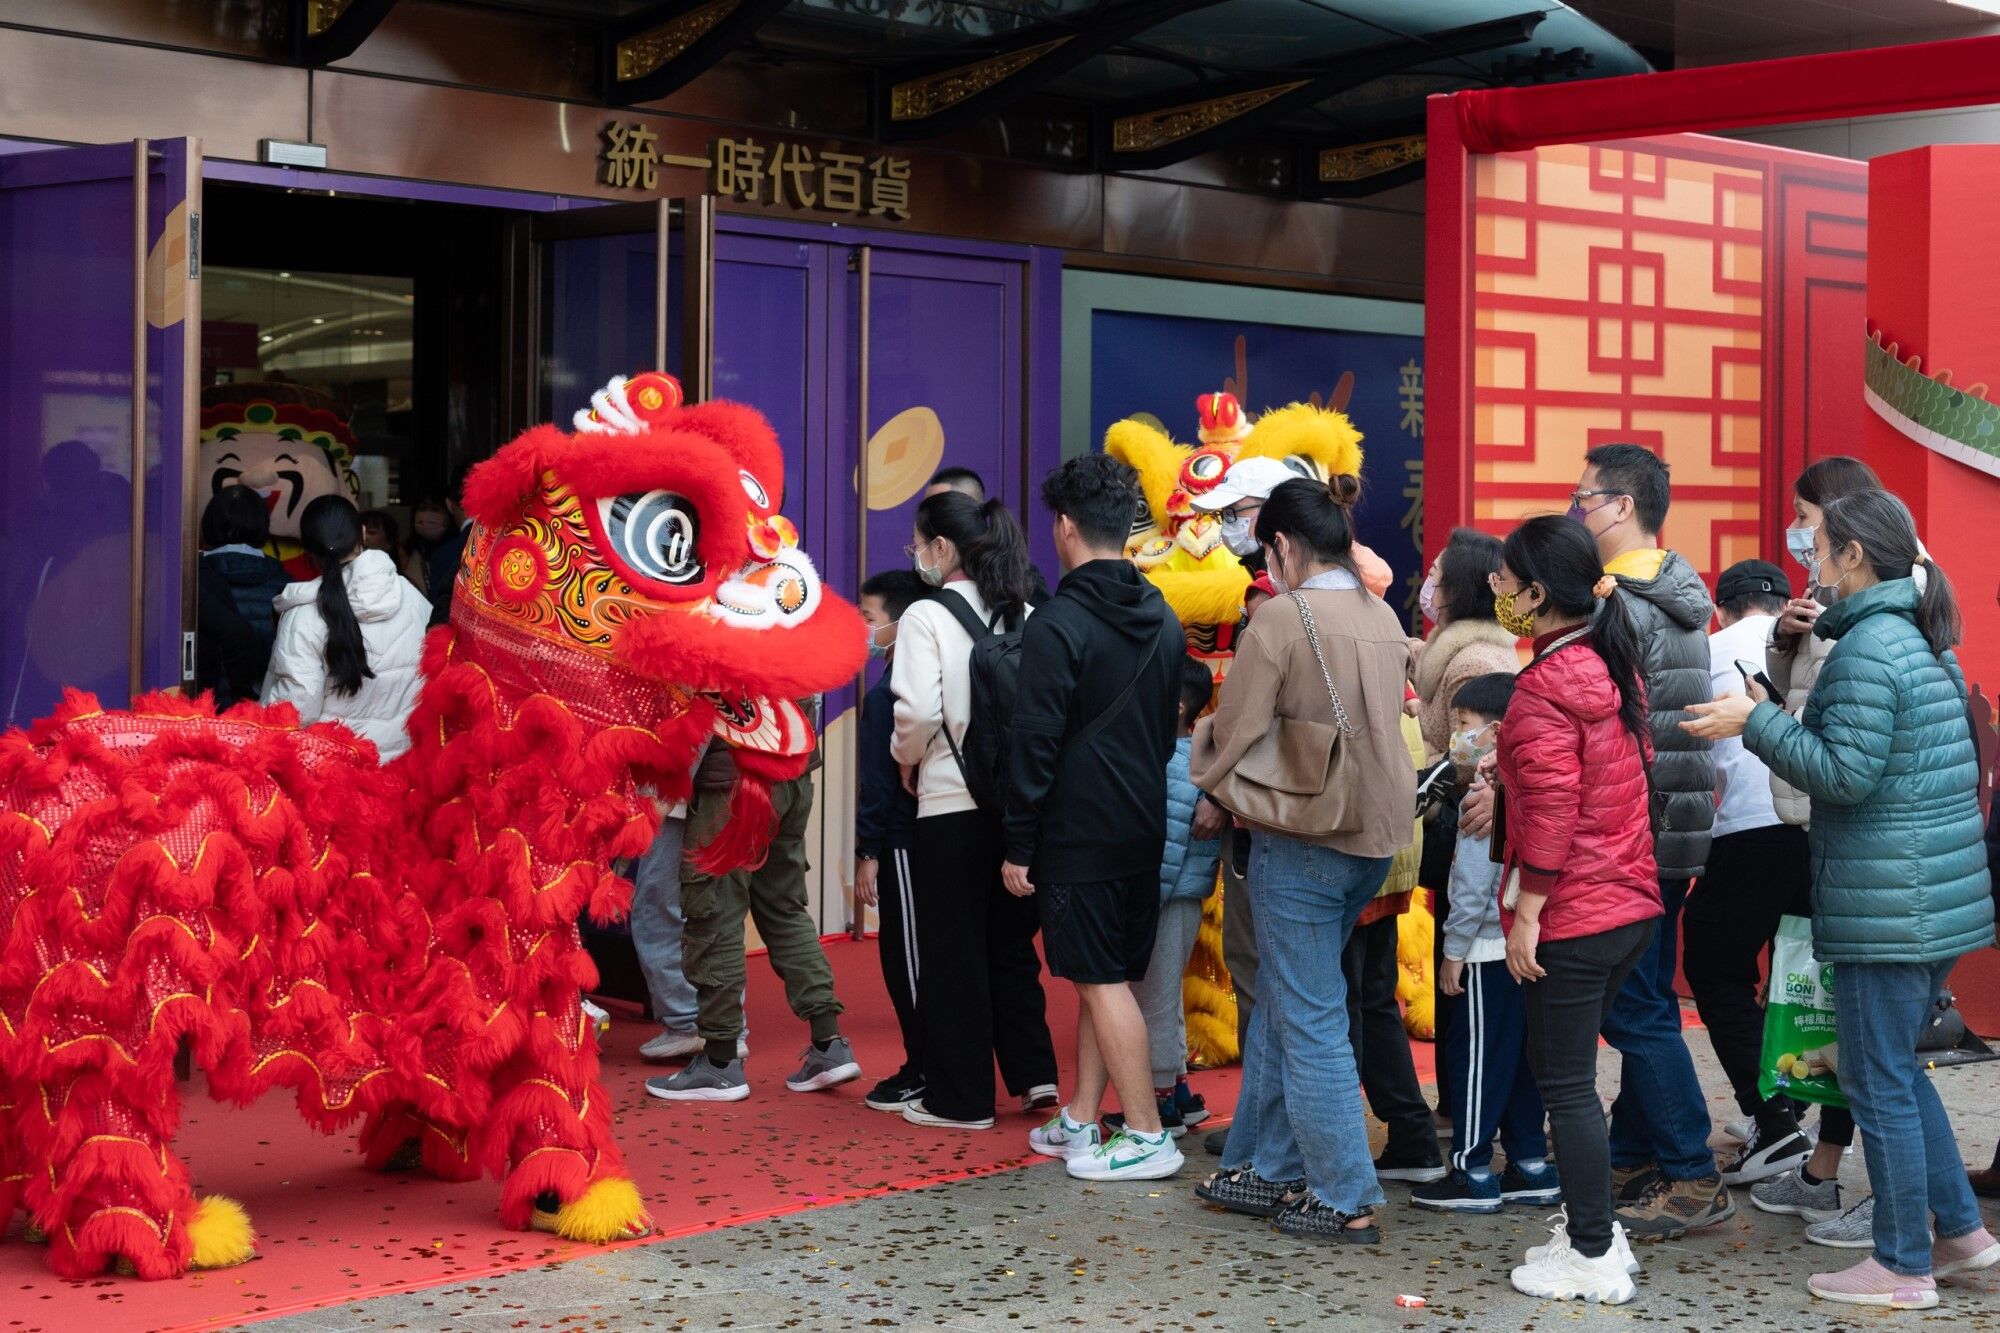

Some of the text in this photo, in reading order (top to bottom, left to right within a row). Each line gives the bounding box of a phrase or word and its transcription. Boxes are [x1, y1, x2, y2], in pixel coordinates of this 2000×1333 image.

[607, 120, 911, 219] 統一時代百貨
